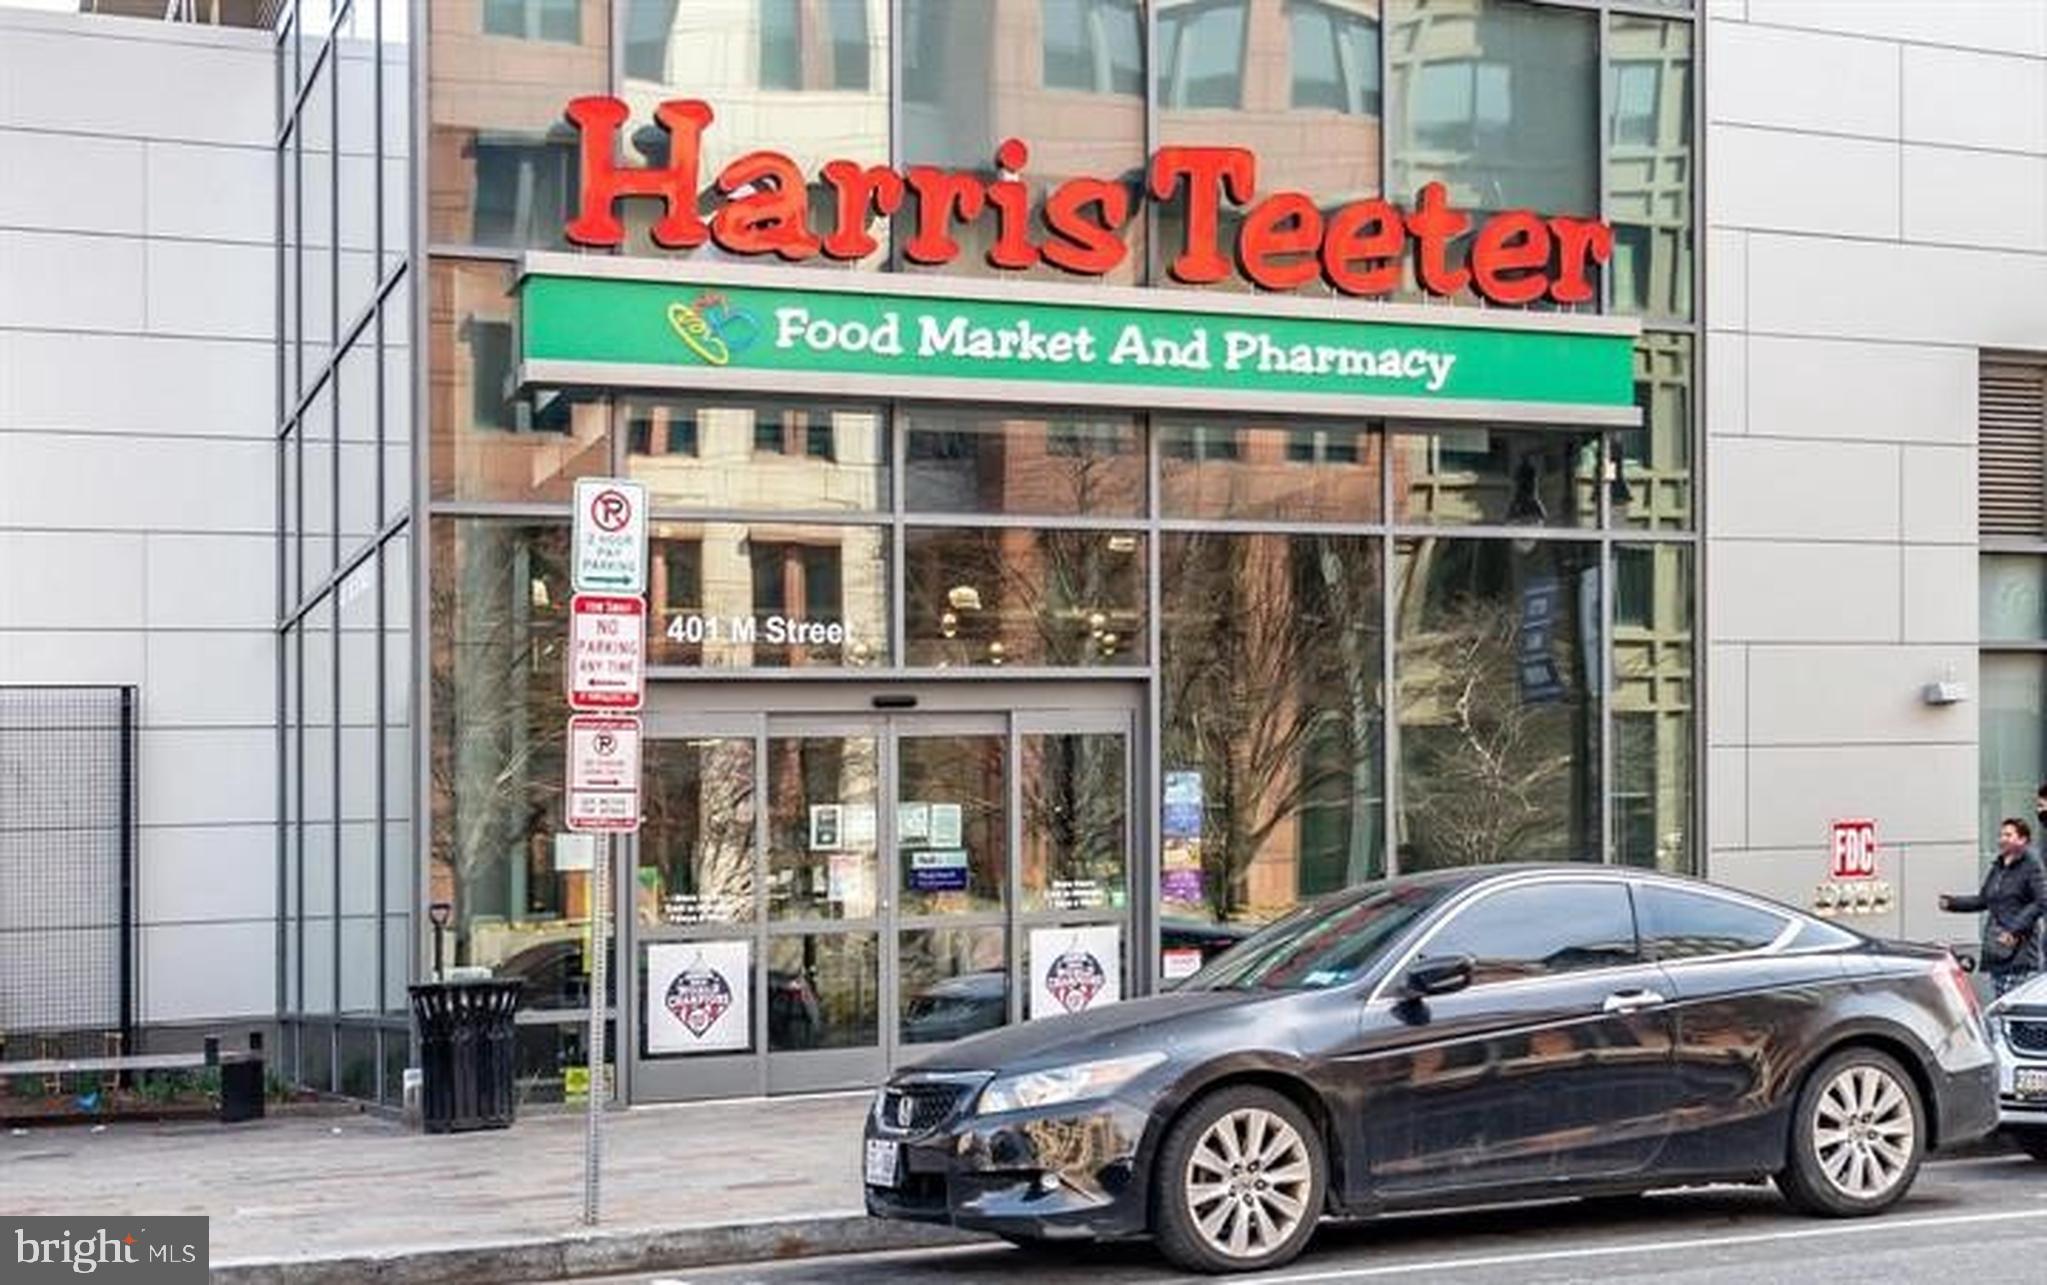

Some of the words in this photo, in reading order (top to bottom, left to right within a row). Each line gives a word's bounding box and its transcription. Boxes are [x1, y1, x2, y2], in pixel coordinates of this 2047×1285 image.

[565, 95, 1130, 275] Harris
[1150, 146, 1614, 304] Teeter
[775, 307, 903, 358] Food
[917, 315, 1095, 364] Market
[1109, 325, 1211, 370] And
[1223, 331, 1456, 392] Pharmacy
[583, 559, 636, 573] PARKING
[597, 619, 618, 635] NO
[667, 615, 718, 643] 401
[732, 616, 756, 643] M
[578, 640, 637, 656] PARKING
[1834, 828, 1874, 872] FDC
